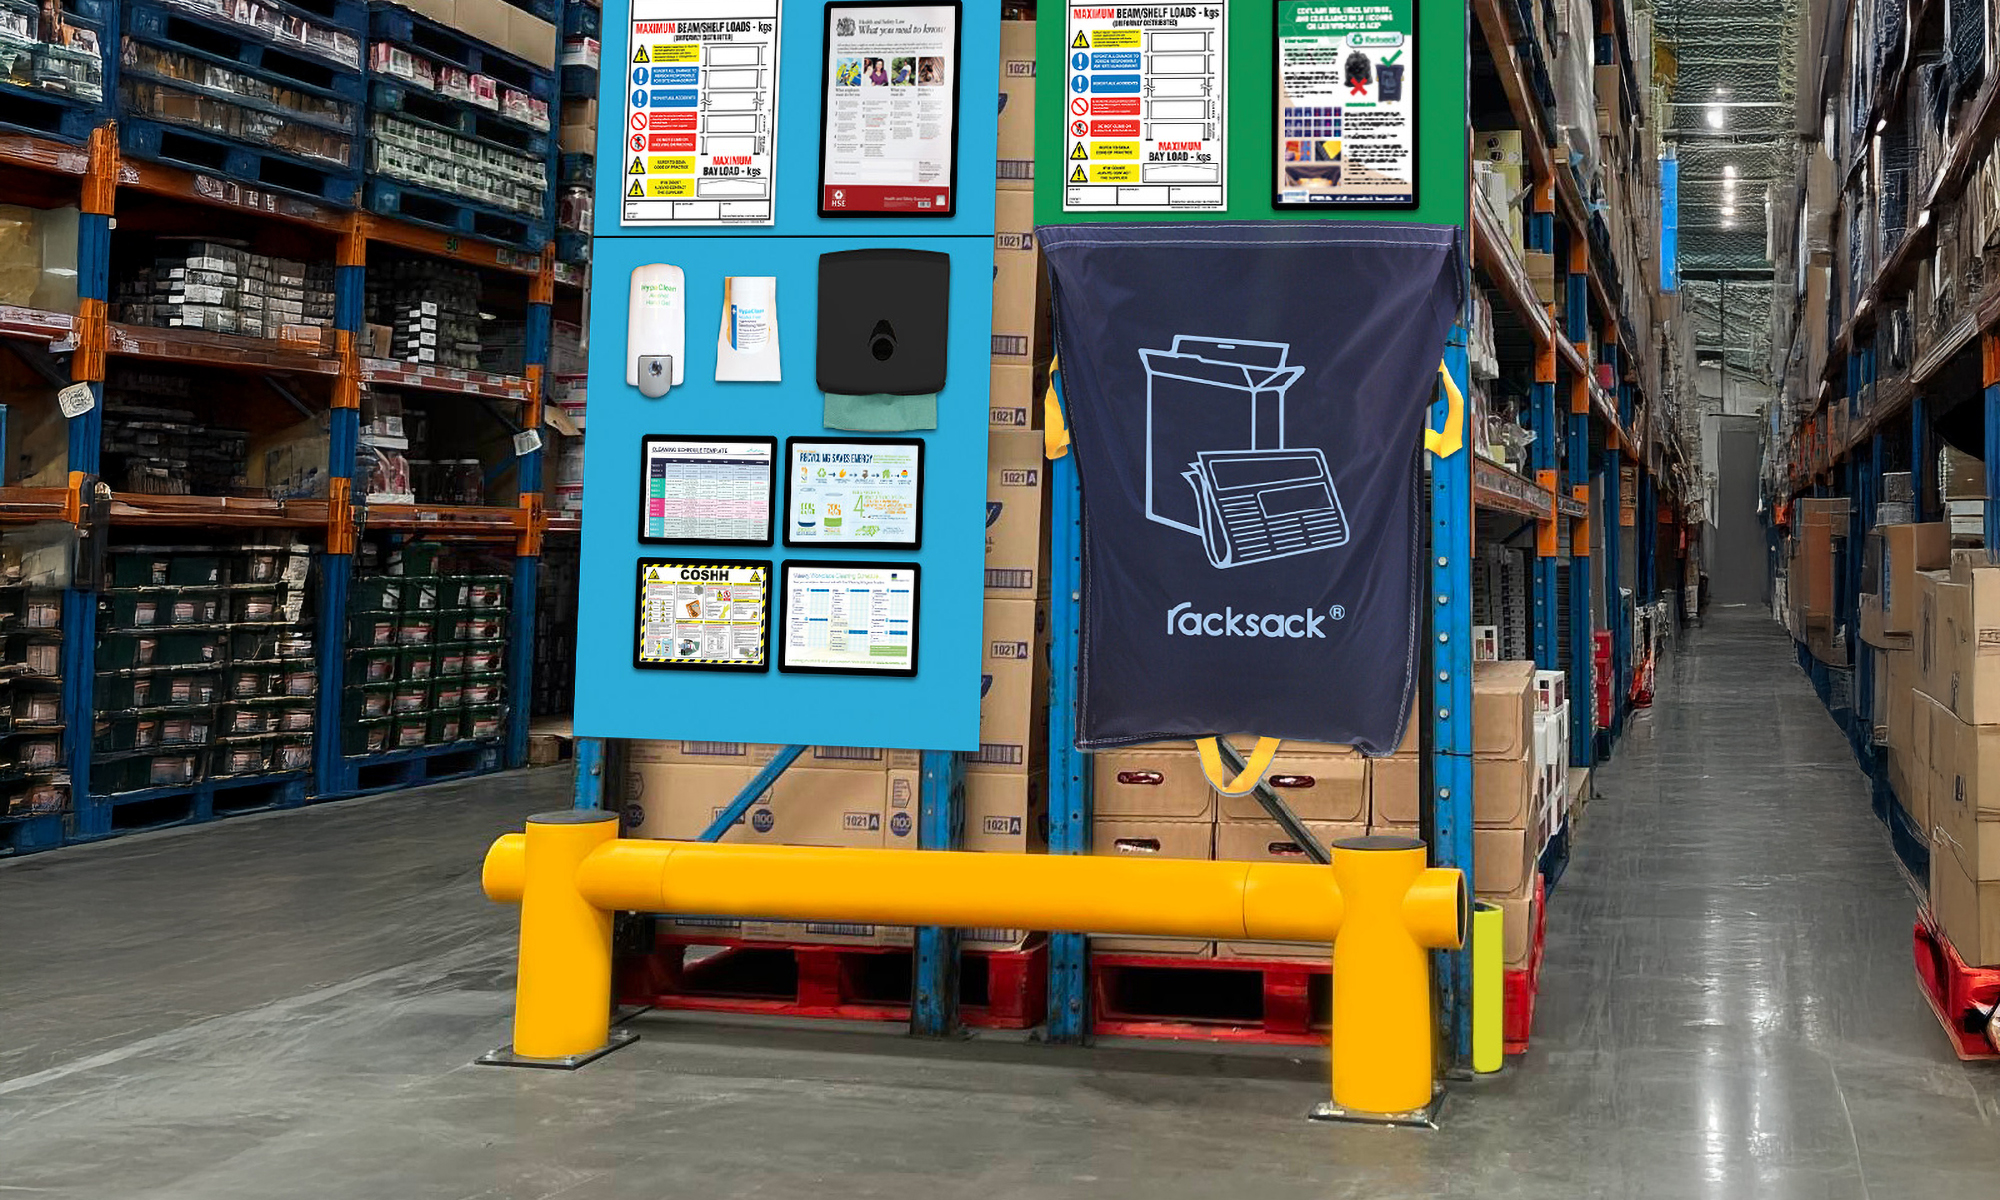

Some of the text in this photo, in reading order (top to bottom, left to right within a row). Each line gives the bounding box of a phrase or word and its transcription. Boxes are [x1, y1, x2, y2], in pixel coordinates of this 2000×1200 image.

[1073, 8, 1115, 19] MAXIMUM
[1116, 7, 1168, 19] BEAM/SHELF
[1170, 7, 1197, 18] LOADS
[1203, 7, 1220, 20] kgs
[635, 22, 676, 34] MAXIMUM
[677, 21, 724, 33] BEAM/SHELF
[725, 21, 751, 33] LOADS
[758, 21, 772, 35] kgs
[858, 23, 946, 36] What you need to know
[1008, 63, 1030, 74] 1021
[1158, 141, 1202, 151] MAXIMUM
[712, 155, 752, 166] MAXIMUM
[1148, 152, 1166, 162] BAY
[1166, 151, 1189, 162] LOAD
[1196, 152, 1212, 164] kgs
[703, 166, 721, 176] BAY
[720, 166, 740, 176] LOAD
[746, 166, 761, 177] kgs
[831, 200, 847, 208] HSE
[998, 235, 1020, 247] 1021
[992, 411, 1014, 423] 1021
[651, 446, 677, 454] CLEANING
[850, 453, 874, 464] ENERGY
[1003, 472, 1025, 484] 1021
[680, 569, 730, 581] COSHH
[1167, 601, 1327, 639] racksack
[993, 643, 1027, 658] 1021 A
[845, 815, 879, 827] 1021 A
[984, 818, 1021, 834] 1021 A
